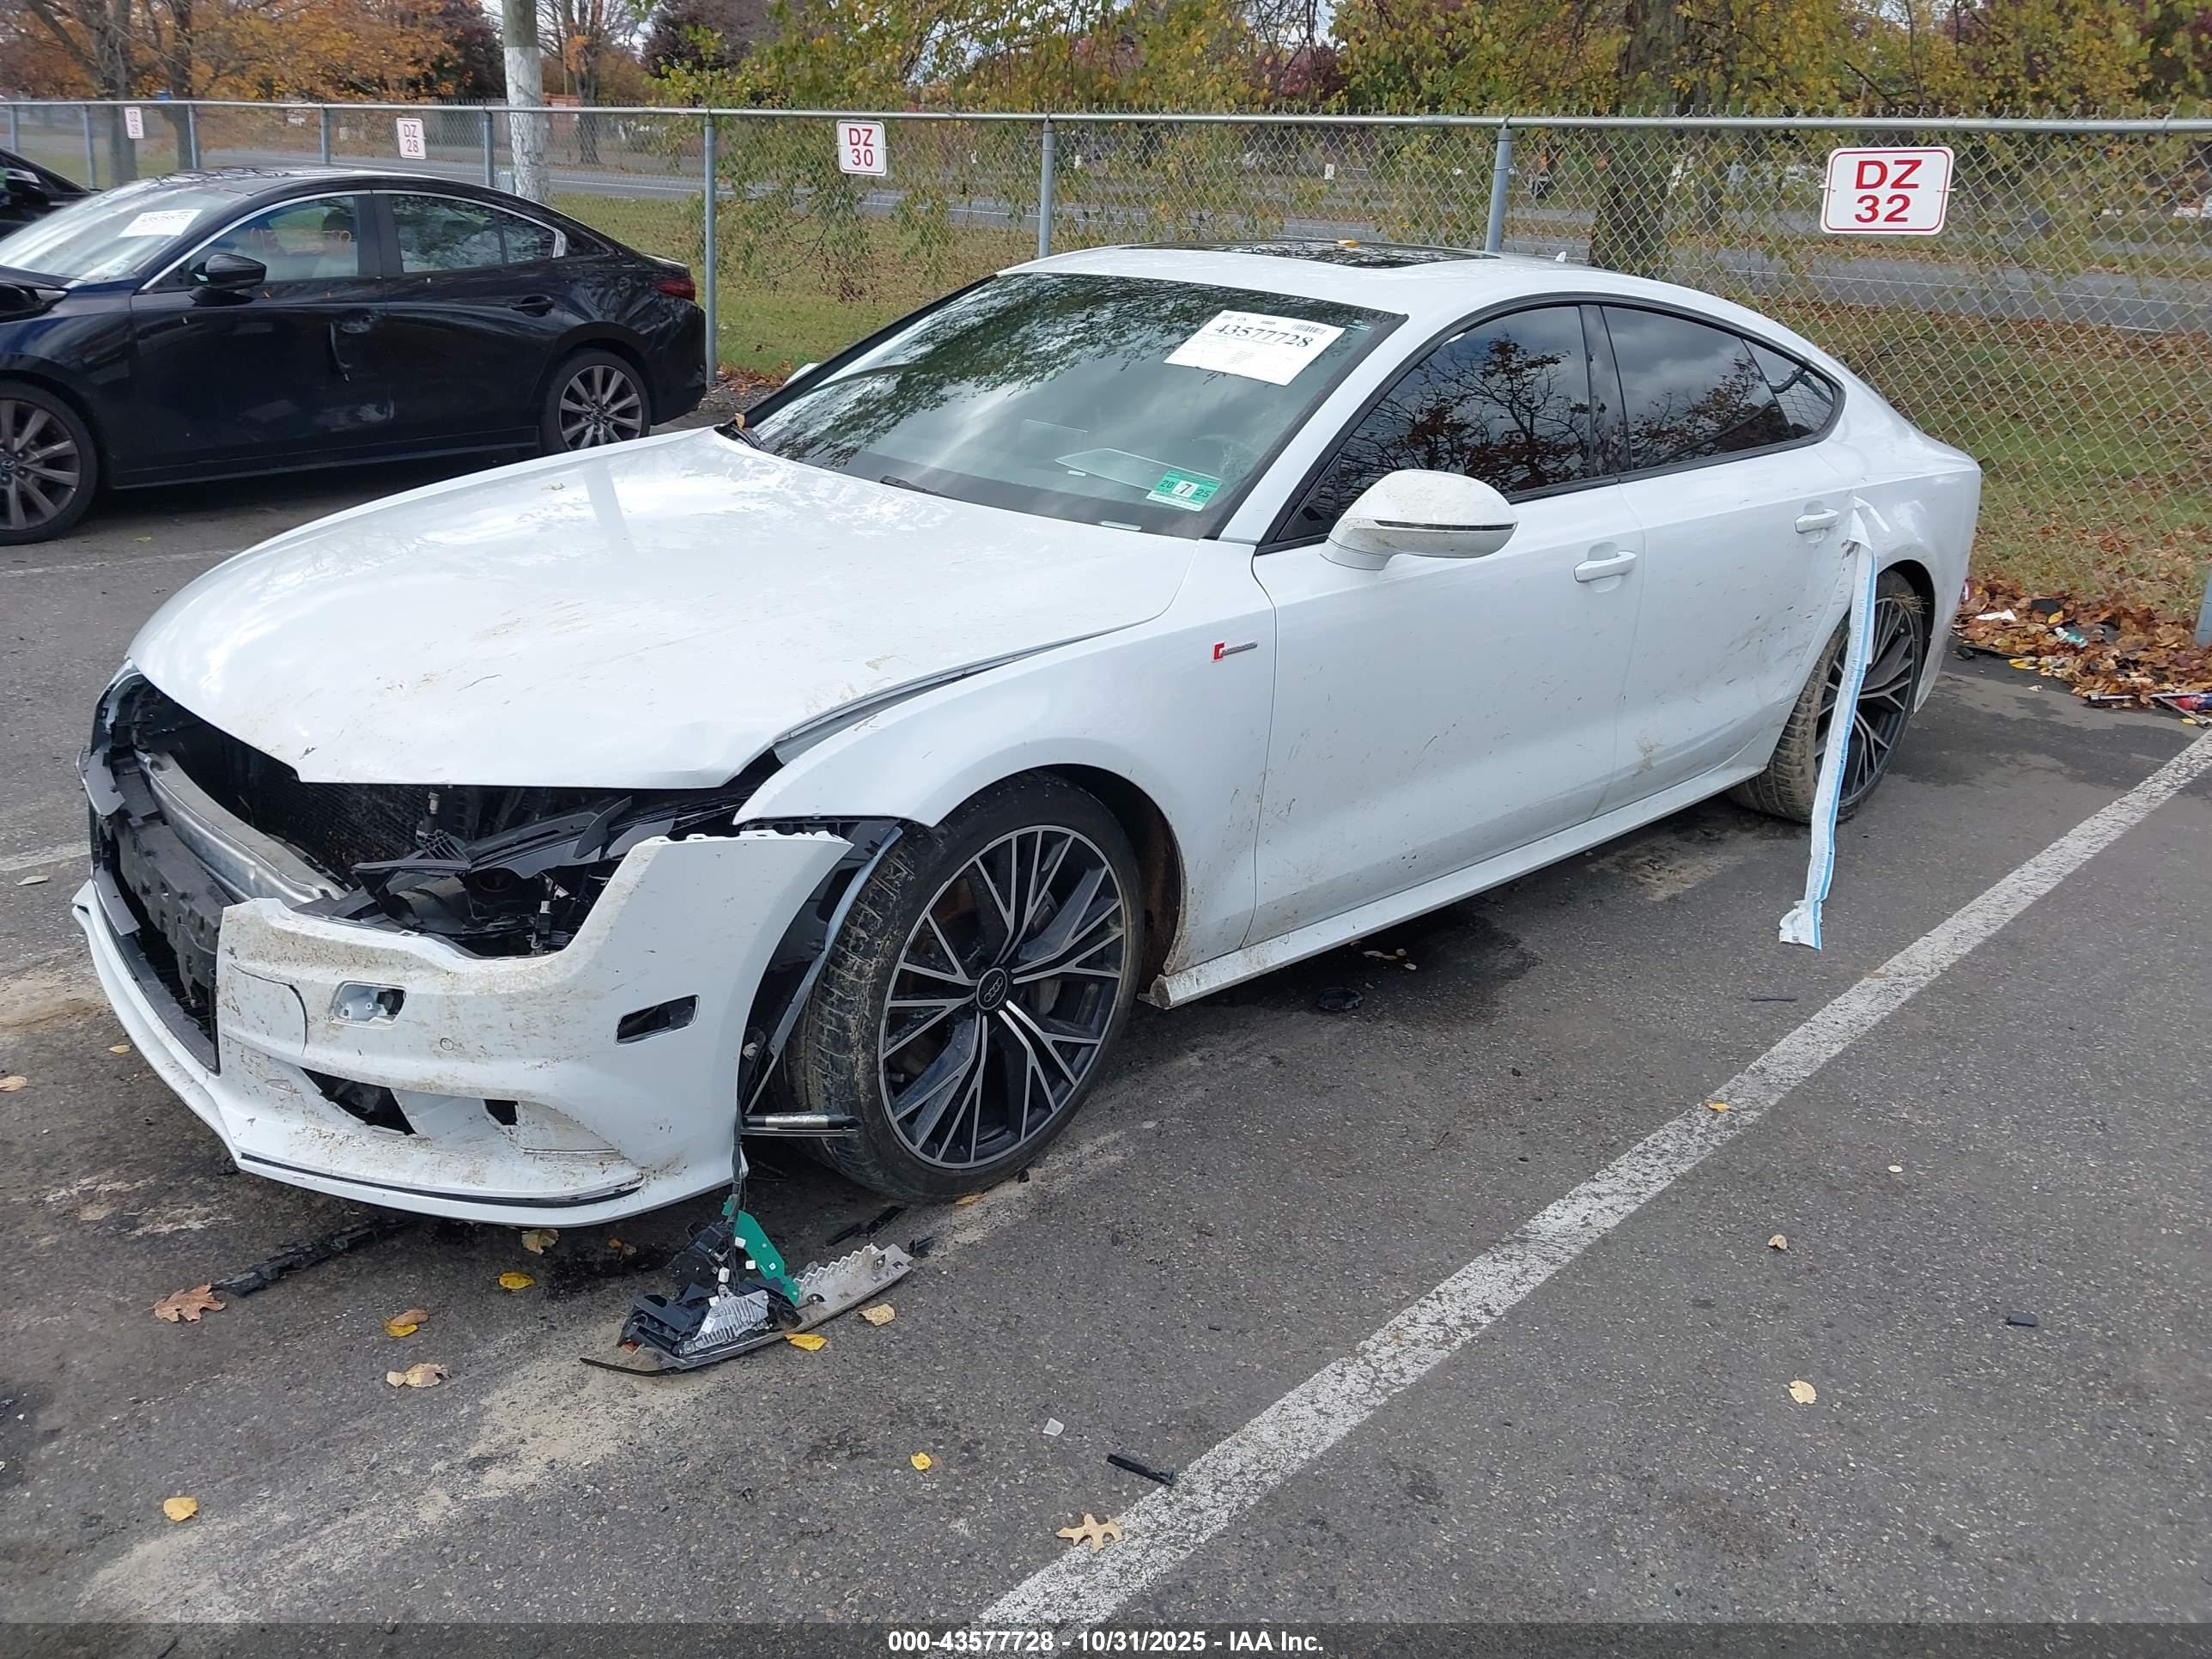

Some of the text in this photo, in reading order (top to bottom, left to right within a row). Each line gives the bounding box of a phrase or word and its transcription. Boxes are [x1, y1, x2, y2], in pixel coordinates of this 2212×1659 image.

[404, 124, 417, 137] DZ
[848, 128, 873, 147] DZ
[406, 139, 419, 153] 28
[852, 149, 873, 167] 30
[1855, 160, 1923, 190] DZ
[1855, 194, 1911, 223] 32
[1215, 325, 1314, 348] 43577728
[1180, 483, 1193, 494] 7
